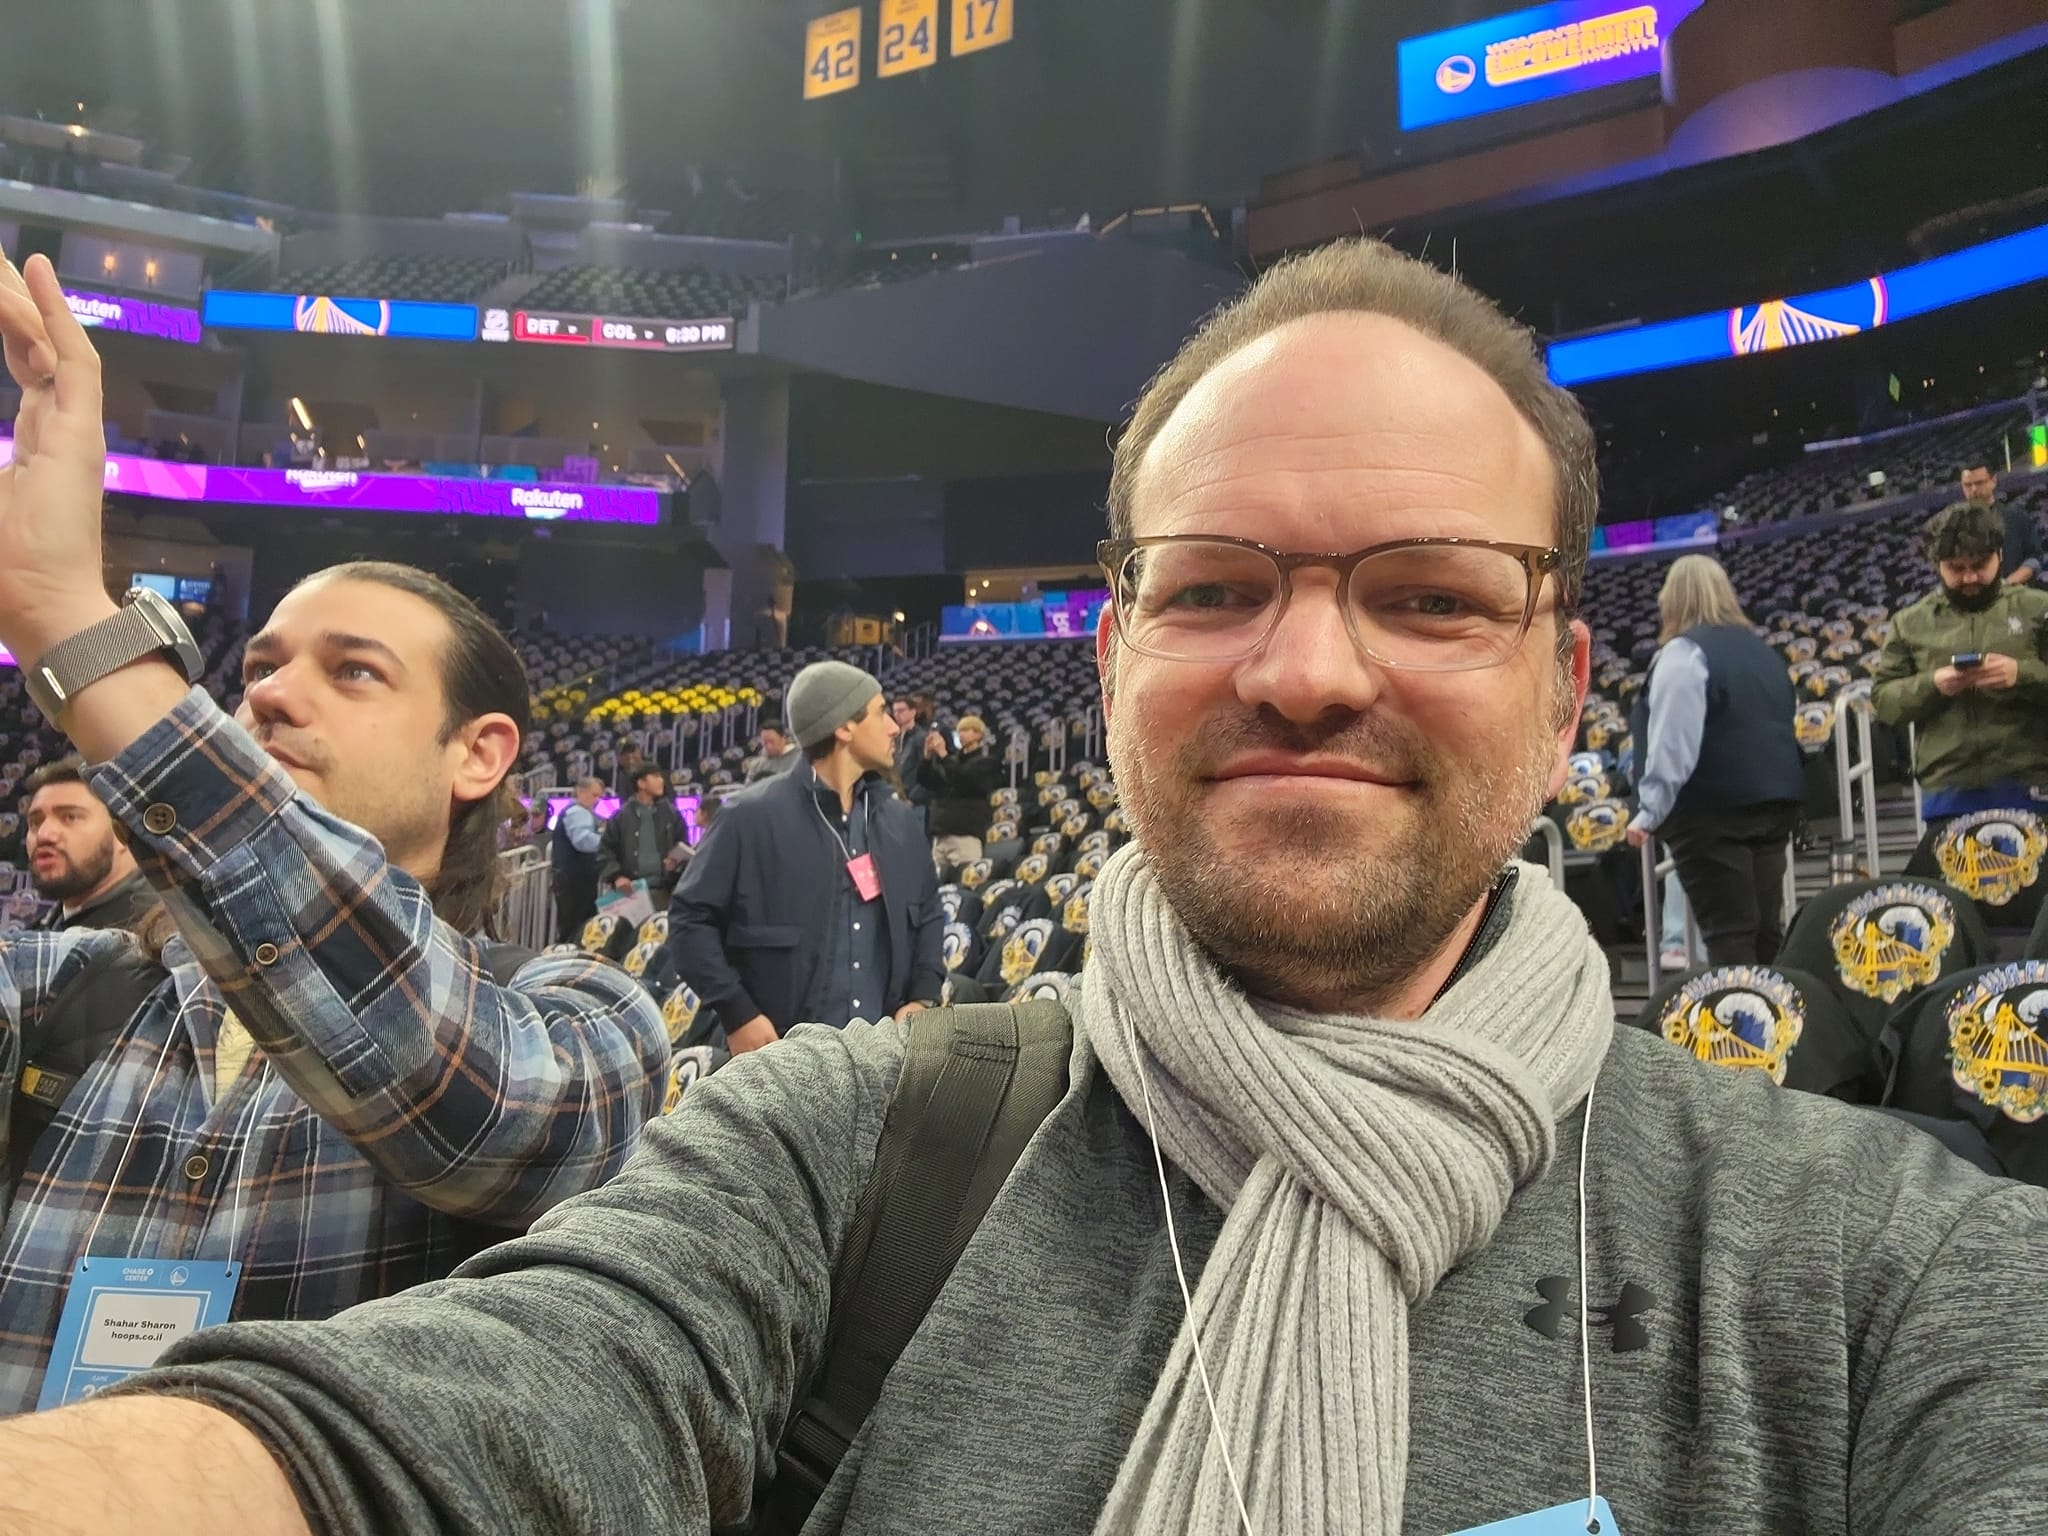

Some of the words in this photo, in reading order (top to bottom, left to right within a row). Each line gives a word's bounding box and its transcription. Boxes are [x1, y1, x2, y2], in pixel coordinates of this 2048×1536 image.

[963, 0, 999, 41] 17
[884, 15, 930, 64] 24
[1486, 16, 1658, 72] EMPOWERMENT
[1582, 35, 1659, 65] MONTH
[811, 40, 854, 83] 42
[701, 324, 727, 342] PM
[511, 487, 583, 510] Rakuten
[104, 1319, 138, 1328] Shahar
[140, 1320, 176, 1330] Sharon
[111, 1331, 163, 1342] hoops.co.il
